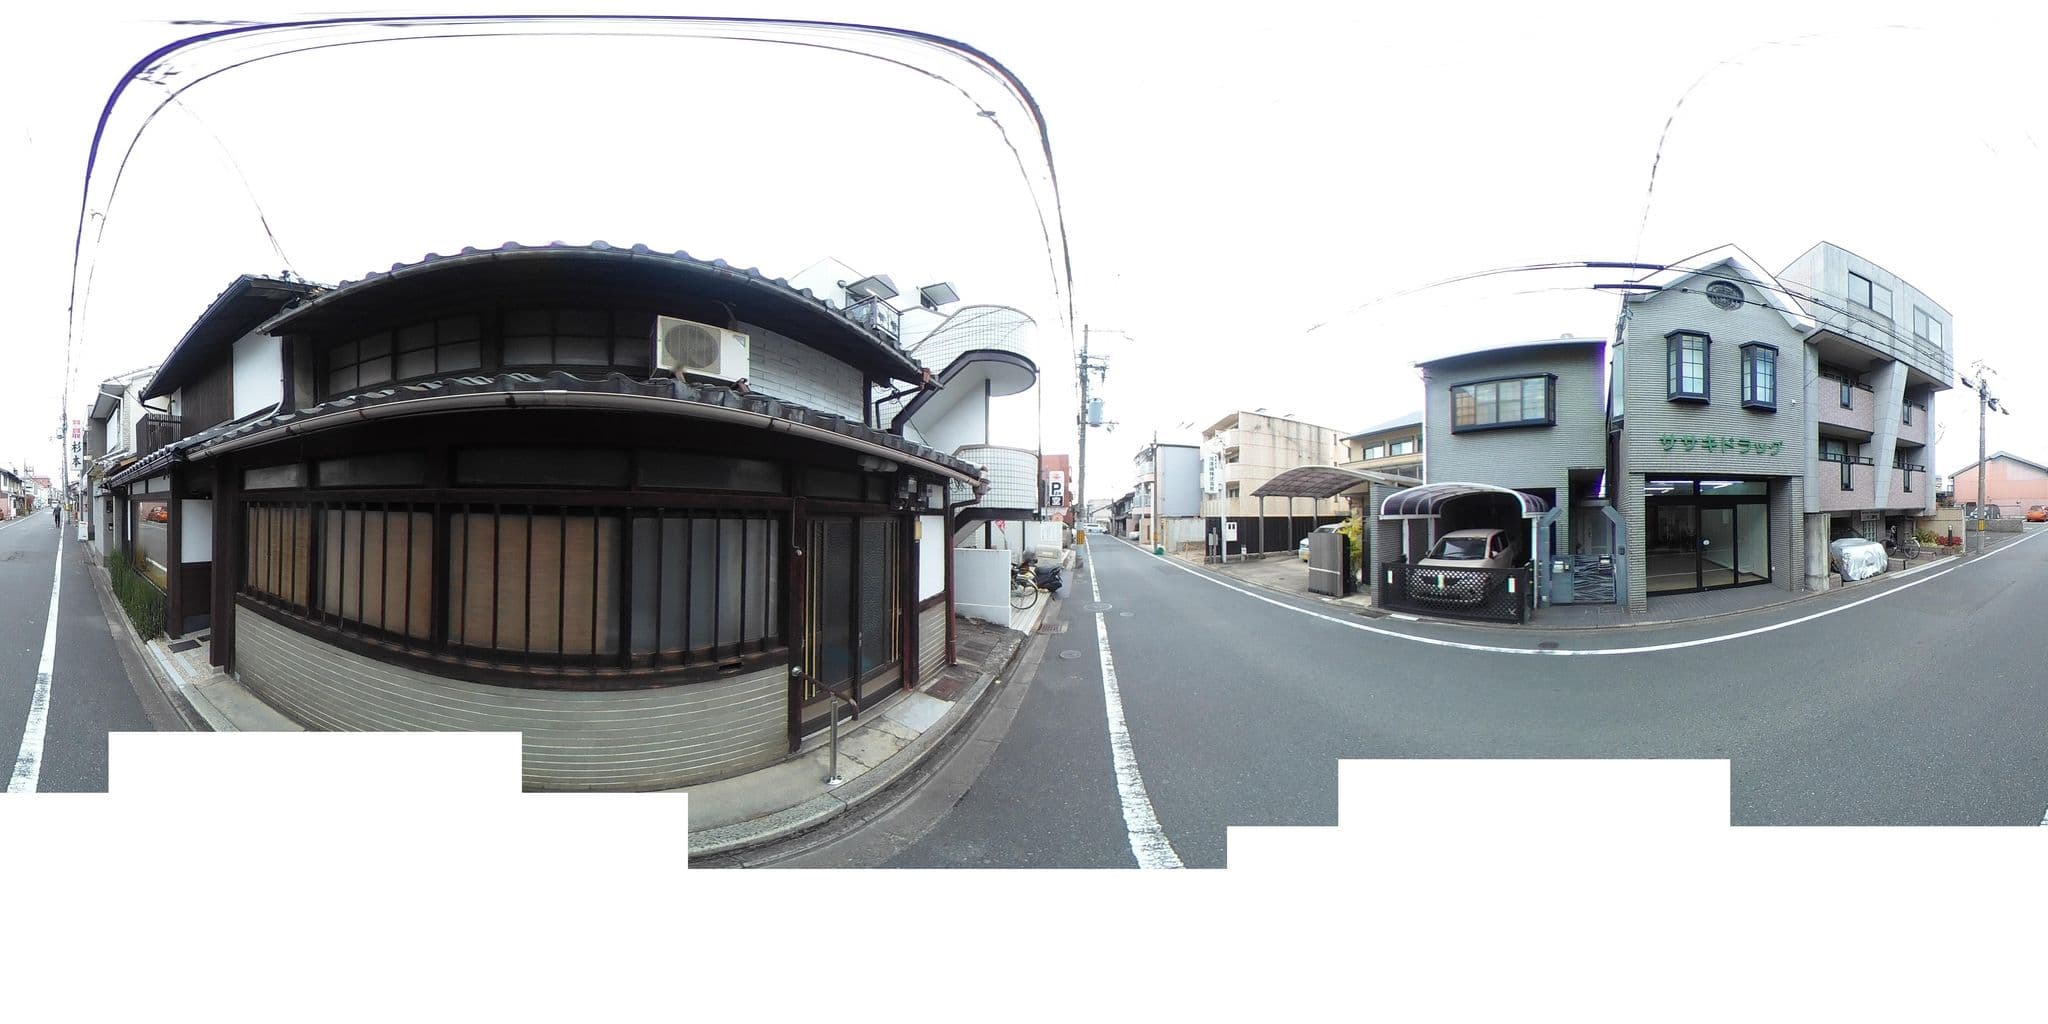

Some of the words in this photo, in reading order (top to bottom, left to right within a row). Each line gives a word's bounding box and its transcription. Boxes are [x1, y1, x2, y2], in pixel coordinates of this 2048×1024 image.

[1659, 433, 1783, 456] ササキドラッグ
[1051, 482, 1061, 495] P
